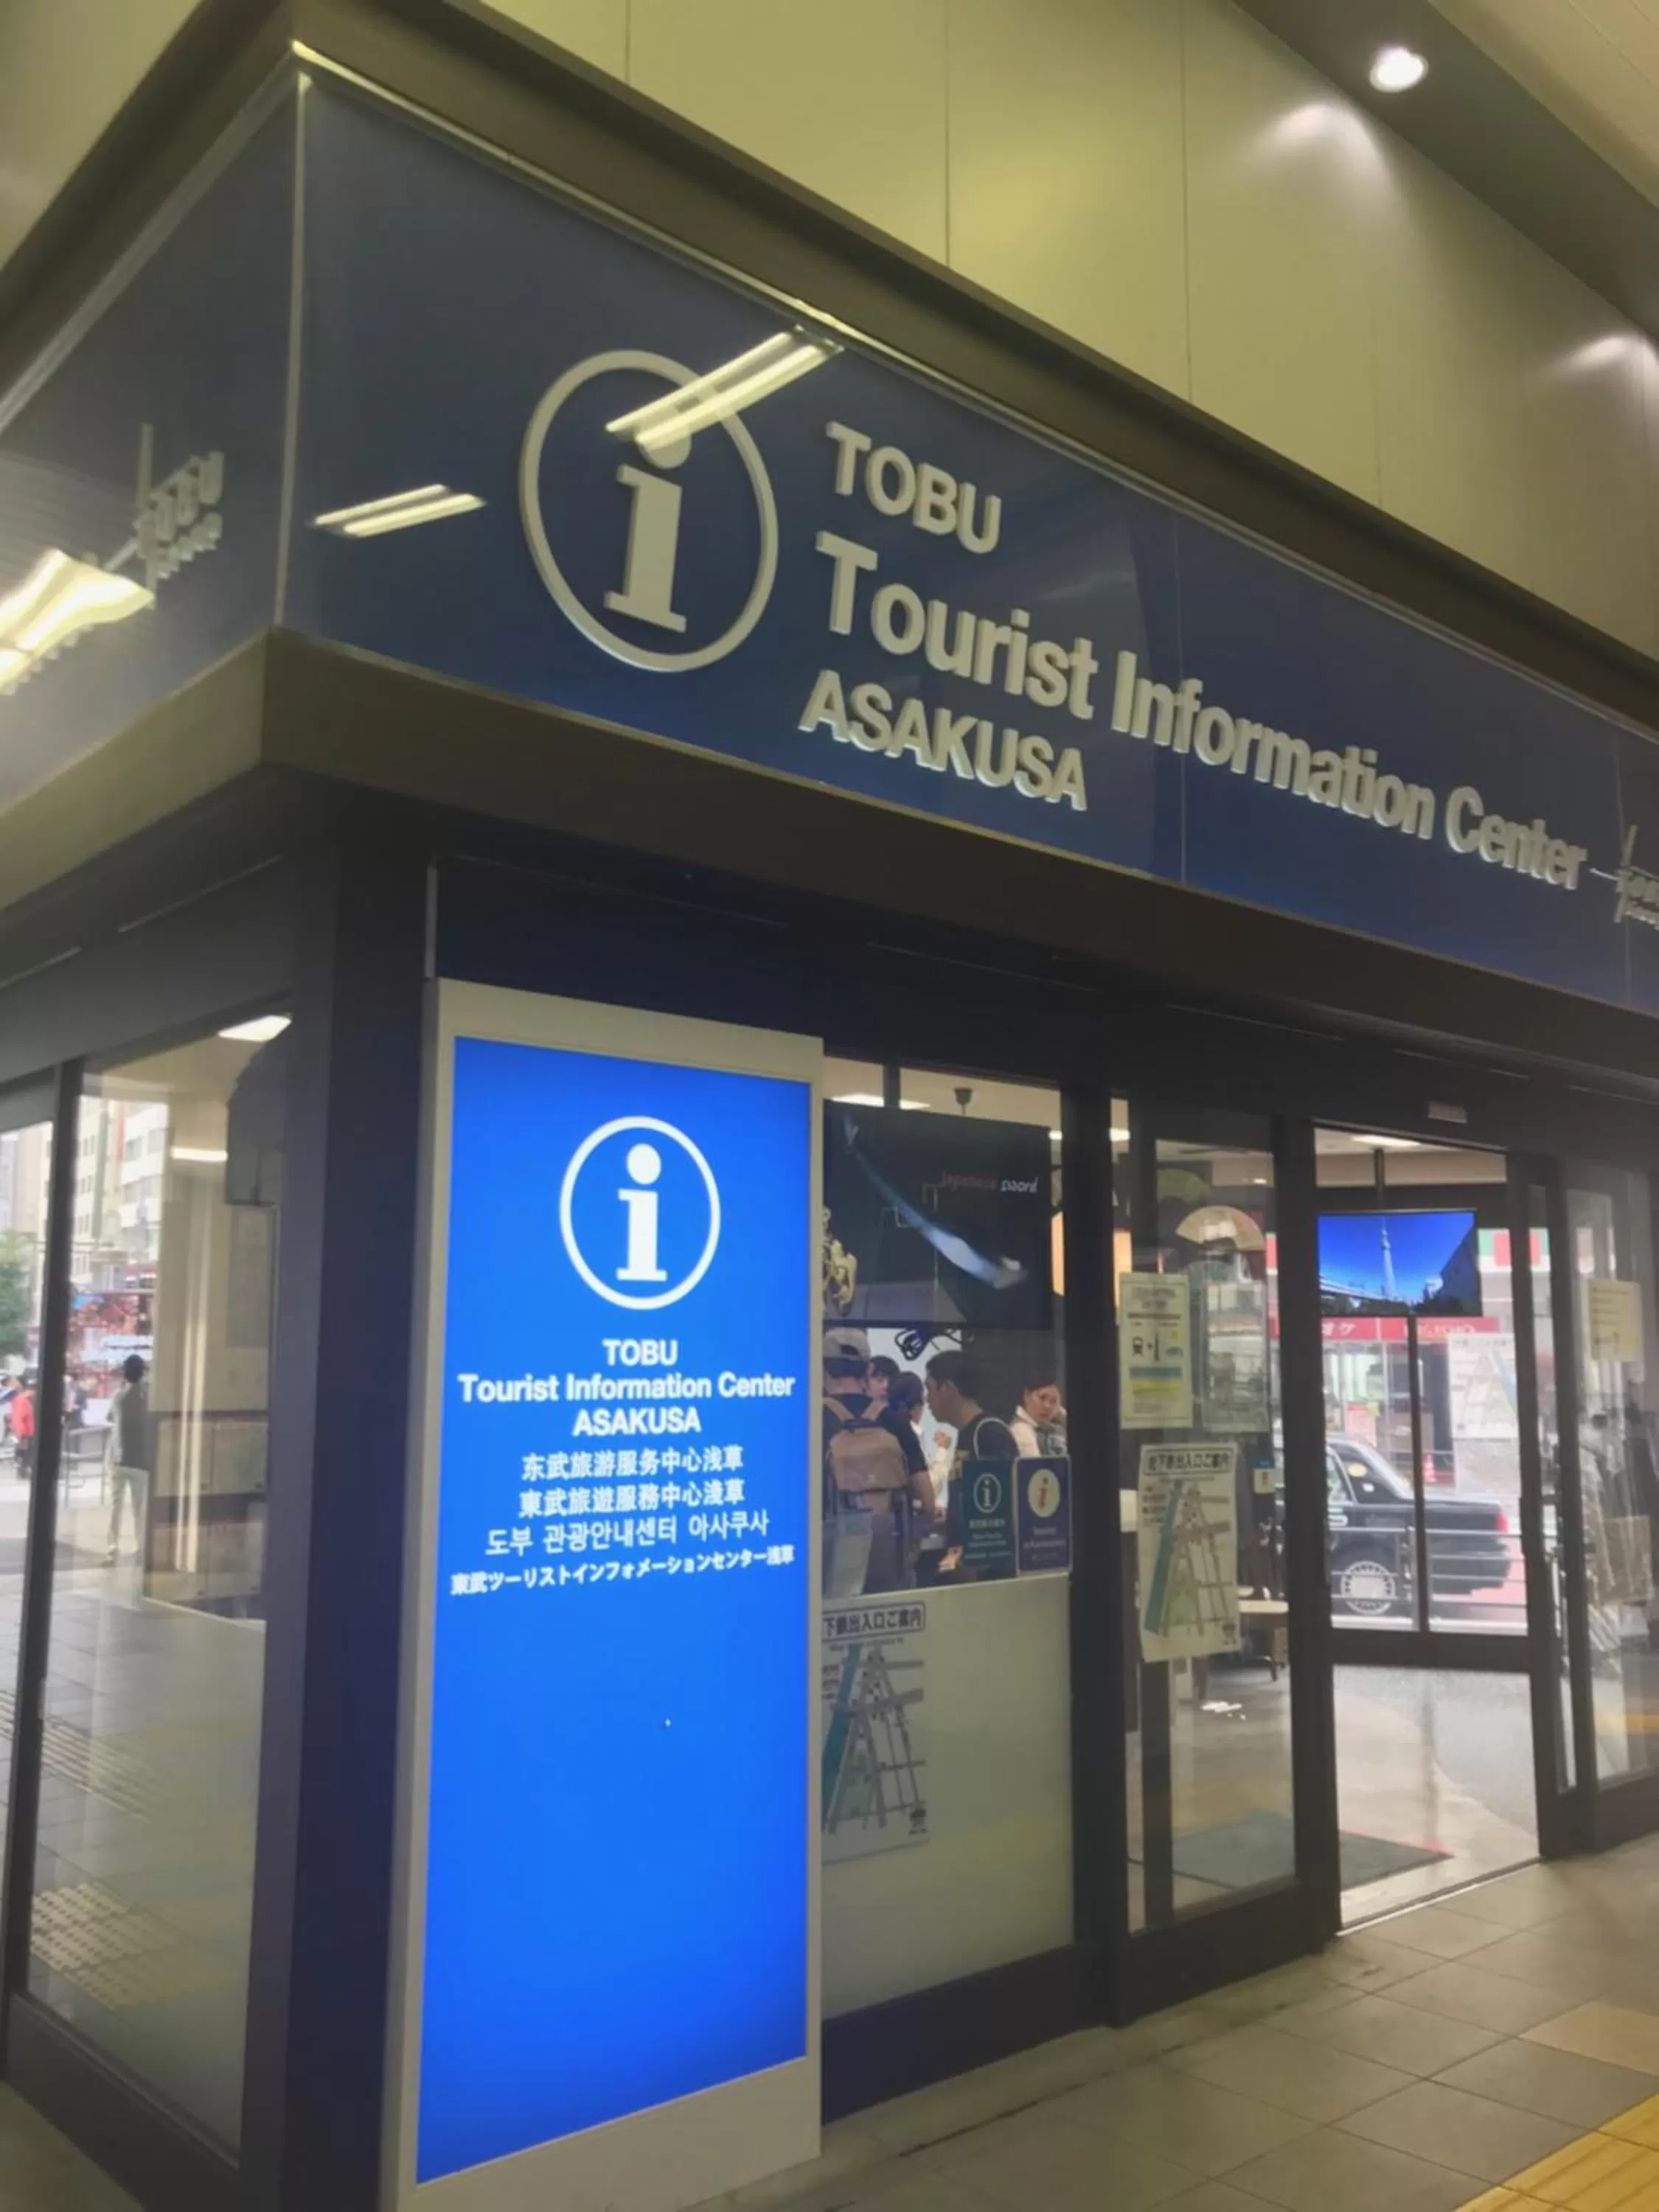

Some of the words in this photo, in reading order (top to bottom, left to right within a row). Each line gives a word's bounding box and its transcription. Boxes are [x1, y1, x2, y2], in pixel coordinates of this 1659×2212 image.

[826, 420, 1001, 554] TOBU
[815, 531, 1099, 720] Tourist
[1111, 649, 1436, 841] Information
[1445, 785, 1587, 891] Center
[798, 669, 1088, 811] ASAKUSA
[602, 1338, 678, 1366] TOBU
[457, 1373, 560, 1403] Tourist
[566, 1372, 712, 1401] Information
[717, 1371, 796, 1398] Center
[572, 1406, 702, 1437] ASAKUSA
[486, 1526, 533, 1557] 도부
[543, 1515, 678, 1554] 관광안내센터
[689, 1509, 769, 1540] 아사쿠사
